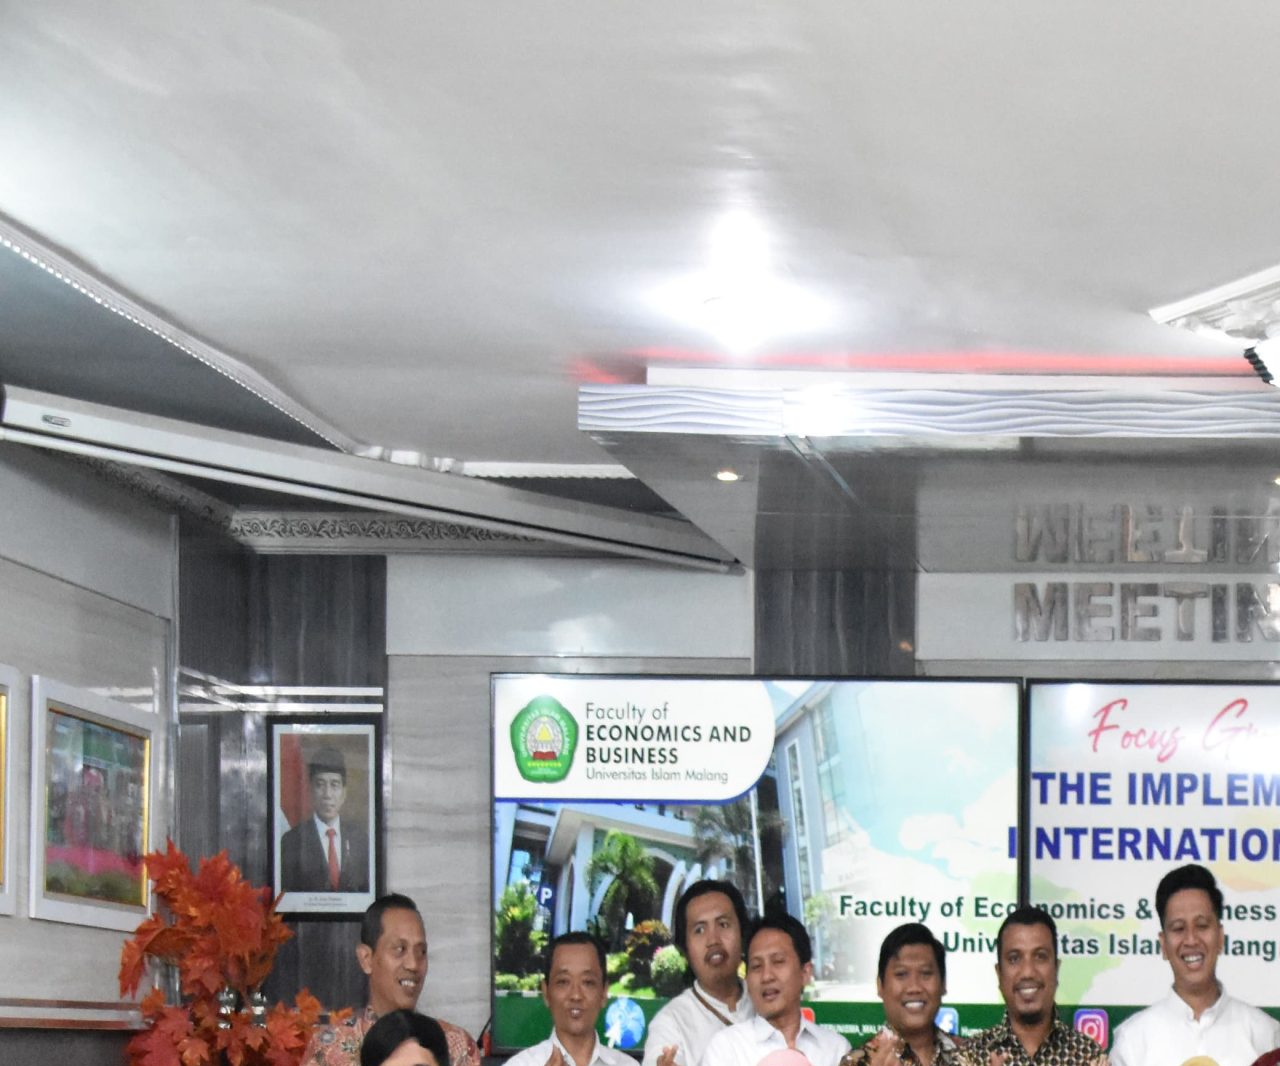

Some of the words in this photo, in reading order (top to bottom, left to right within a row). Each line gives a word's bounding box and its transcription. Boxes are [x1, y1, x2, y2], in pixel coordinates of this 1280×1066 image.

[585, 702, 646, 724] Faculty
[652, 702, 669, 721] of
[586, 724, 703, 742] ECONOMICS
[709, 725, 752, 743] AND
[1087, 697, 1183, 763] Focus
[586, 746, 679, 764] BUSINESS
[586, 767, 647, 781] Universitas
[651, 767, 681, 781] Islam
[685, 769, 729, 784] Malang
[1032, 771, 1112, 806] THE
[839, 895, 931, 922] Faculty
[940, 896, 965, 918] of
[1135, 898, 1152, 920] &
[1224, 935, 1276, 961] lang
